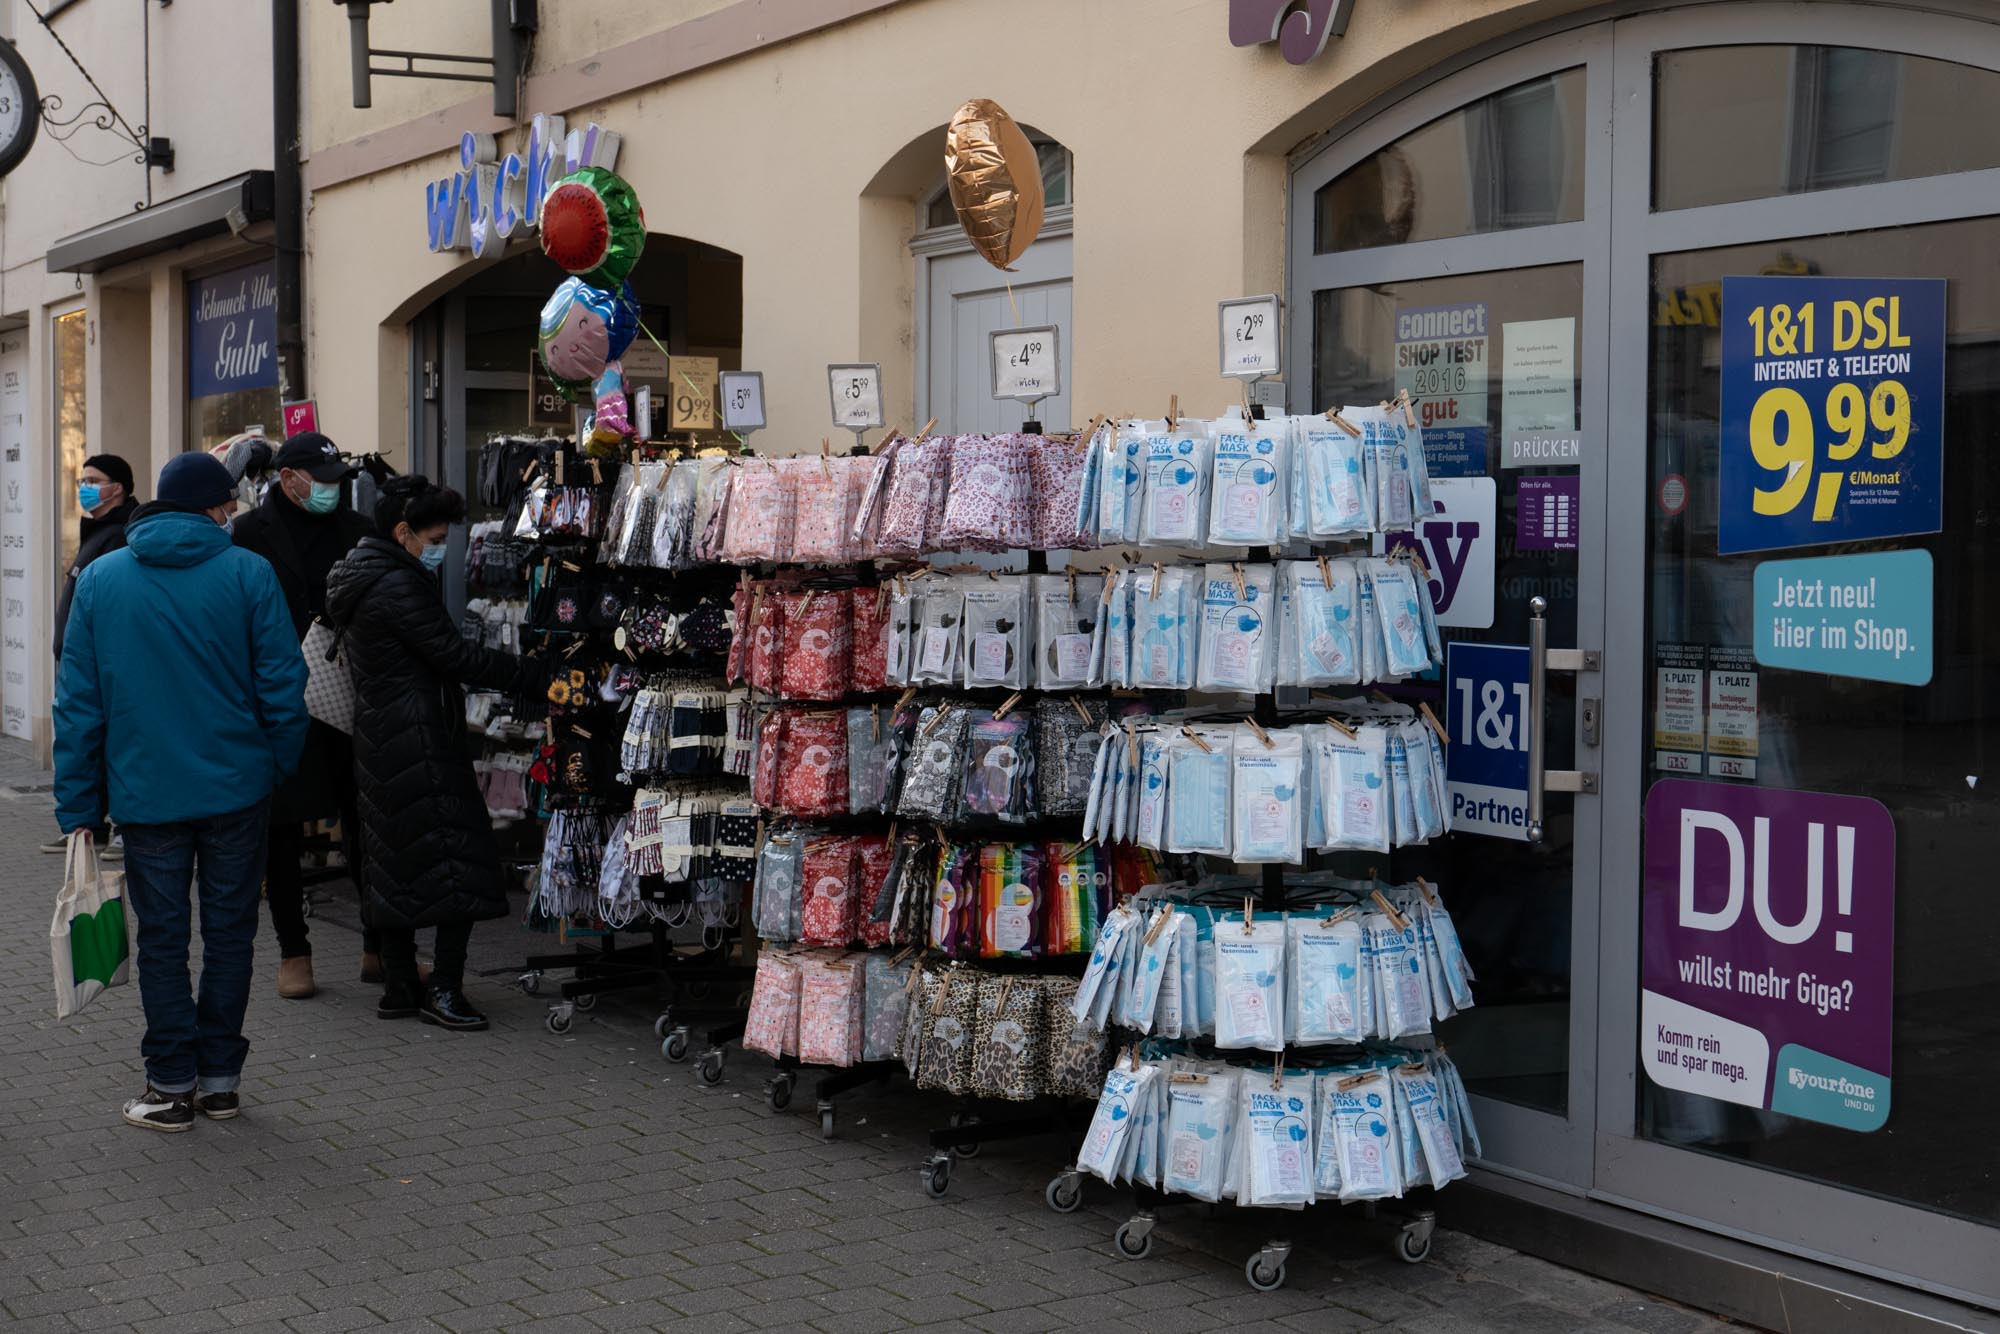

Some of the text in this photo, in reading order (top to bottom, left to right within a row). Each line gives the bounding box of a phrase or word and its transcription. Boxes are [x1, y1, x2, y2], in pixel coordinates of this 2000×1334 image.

[197, 281, 247, 323] Schmuck
[1399, 304, 1485, 339] connect
[1748, 302, 1814, 356] 1&1
[1833, 296, 1911, 351] DSL
[215, 319, 268, 380] Guhr
[1399, 340, 1484, 367] SHOP TEST
[1415, 367, 1466, 393] 2016
[1754, 353, 1910, 381] INTERNET & TELEFON
[1421, 397, 1458, 428] gut
[1219, 444, 1249, 452] MASK
[1220, 434, 1245, 443] FACE
[1513, 437, 1579, 458] DRÜCKEN
[1438, 453, 1469, 463] Erlangen
[1850, 471, 1900, 484] €/Monat
[1209, 581, 1233, 590] FACE
[1209, 590, 1236, 598] MASK
[1772, 577, 1876, 608] Jetzt neu!
[1773, 617, 1915, 658] Hier im Shop.
[1665, 674, 1696, 683] 1. PLATZ
[1718, 677, 1750, 687] 1. PLATZ
[1456, 678, 1530, 751] 1&1
[1668, 756, 1688, 769] n-tv
[1721, 761, 1743, 775] n-tv
[1679, 808, 1855, 953] DU!
[1678, 955, 1853, 1016] willst mehr Giga?
[1657, 1024, 1721, 1054] Komm rein
[1657, 1048, 1748, 1083] und spar mega.
[1251, 1093, 1275, 1101] FACE
[1794, 1070, 1875, 1100] yourfone
[1253, 1101, 1282, 1109] MASK
[1844, 1099, 1875, 1113] UND DU
